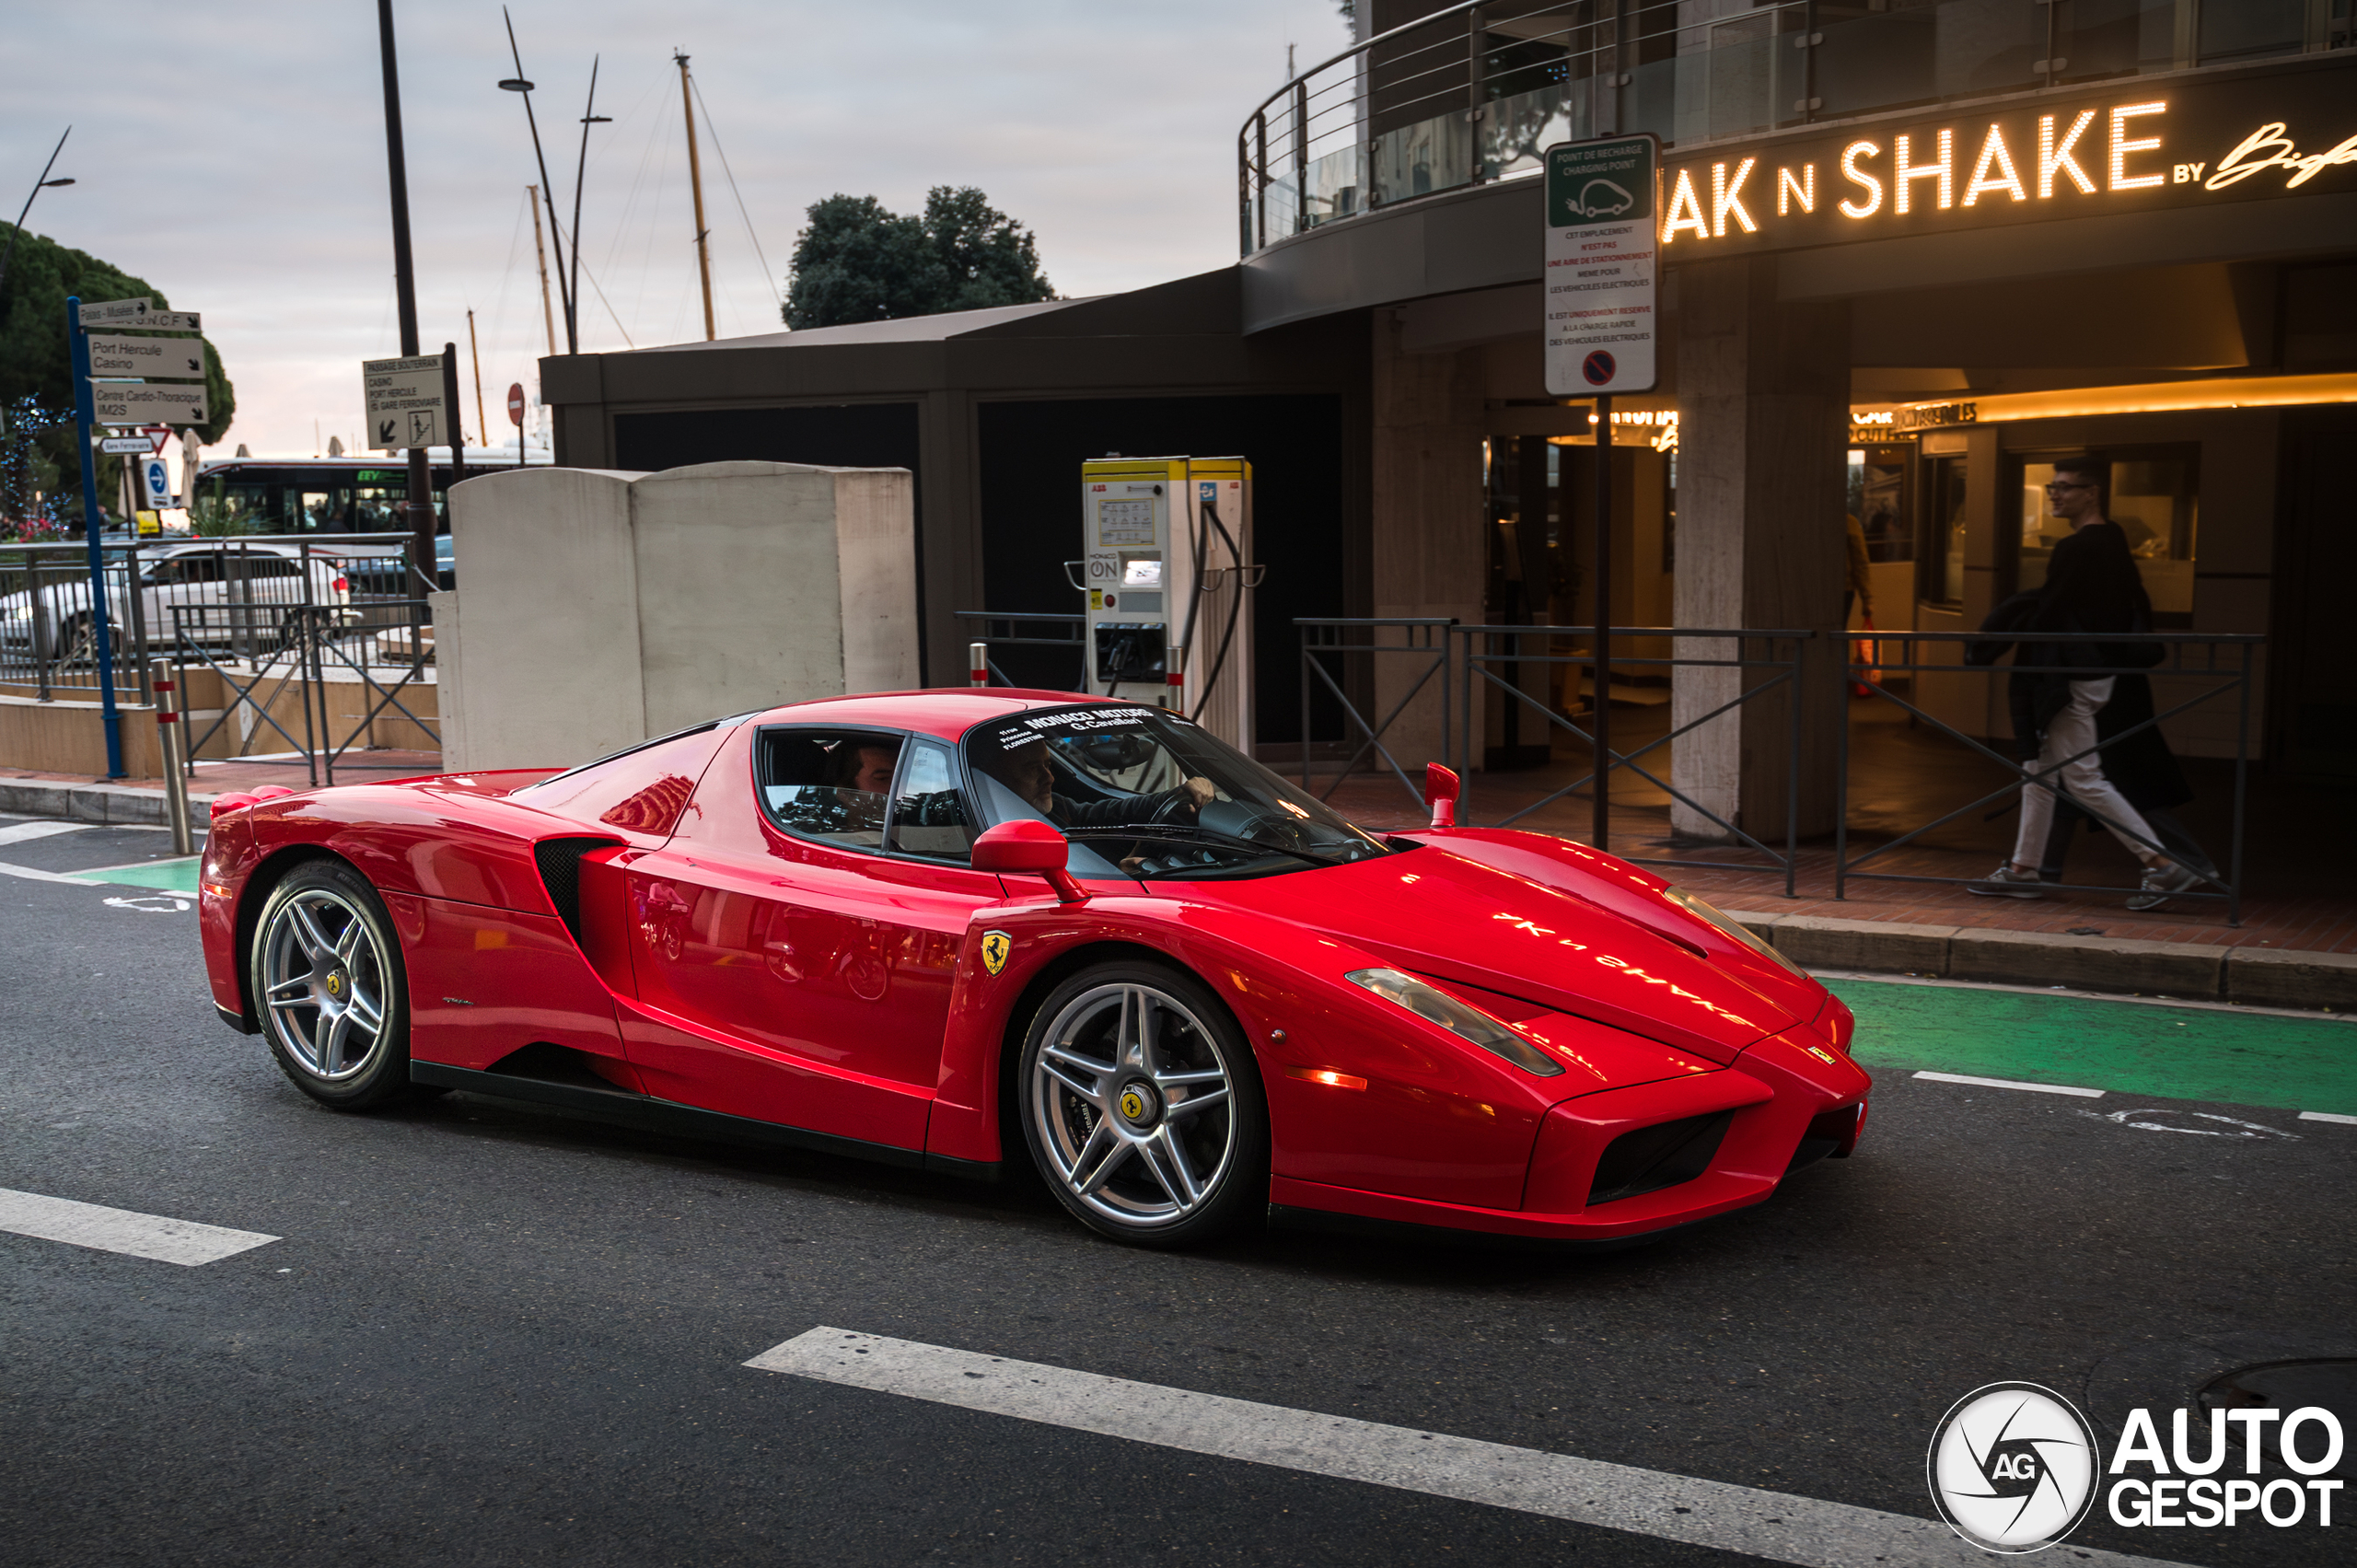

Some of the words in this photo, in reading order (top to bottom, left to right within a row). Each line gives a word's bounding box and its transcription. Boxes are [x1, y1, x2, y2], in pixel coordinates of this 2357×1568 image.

[1556, 152, 1583, 164] POINT
[1584, 150, 1596, 160] DE
[1596, 145, 1643, 158] RECHARGE
[1777, 163, 1816, 217] N
[1837, 99, 2167, 219] SHAKE
[2173, 161, 2206, 184] BY
[1562, 162, 1608, 176] CHARGING
[1608, 159, 1636, 170] POINT
[1580, 226, 1634, 238] EMPLACEMENT
[1581, 242, 1602, 250] N'EST
[1602, 241, 1618, 250] PAS
[1547, 260, 1563, 268] UNE
[1562, 258, 1580, 266] AIRE
[1591, 251, 1654, 263] STATIONNEMENT
[1600, 267, 1620, 276] POUR
[1550, 285, 1563, 294] LES
[1563, 282, 1601, 292] VEHICULES
[1602, 278, 1651, 290] ELECTRIQUES
[1568, 308, 1619, 319] UNIQUEMENT
[1619, 306, 1652, 315] RESERVE
[1569, 324, 1578, 332] LA
[1579, 322, 1609, 331] CHARGE
[1609, 319, 1637, 329] RAPIDE
[1549, 339, 1563, 347] DES
[1563, 336, 1602, 345] VEHICULES
[1602, 332, 1651, 343] ELECTRIQUES
[92, 343, 116, 354] Port
[119, 344, 163, 356] Hercule
[94, 357, 134, 369] Casino
[366, 362, 397, 373] PASSAGE
[369, 377, 392, 388] CASINO
[96, 389, 125, 401] Centre
[126, 390, 202, 404] Cardio-Thoracique
[370, 389, 386, 399] PORT
[388, 388, 417, 398] HERCULE
[98, 405, 128, 416] IM2S
[380, 401, 398, 411] GARE
[400, 398, 442, 409] FERROVIAIRE
[357, 470, 379, 482] EEV
[1092, 483, 1107, 493] ABB
[1090, 560, 1118, 578] ON
[1024, 712, 1095, 730] MONACO
[1091, 708, 1154, 720] MOTORS
[1000, 731, 1032, 743] Princesse
[1003, 733, 1045, 750] FLORESTINE
